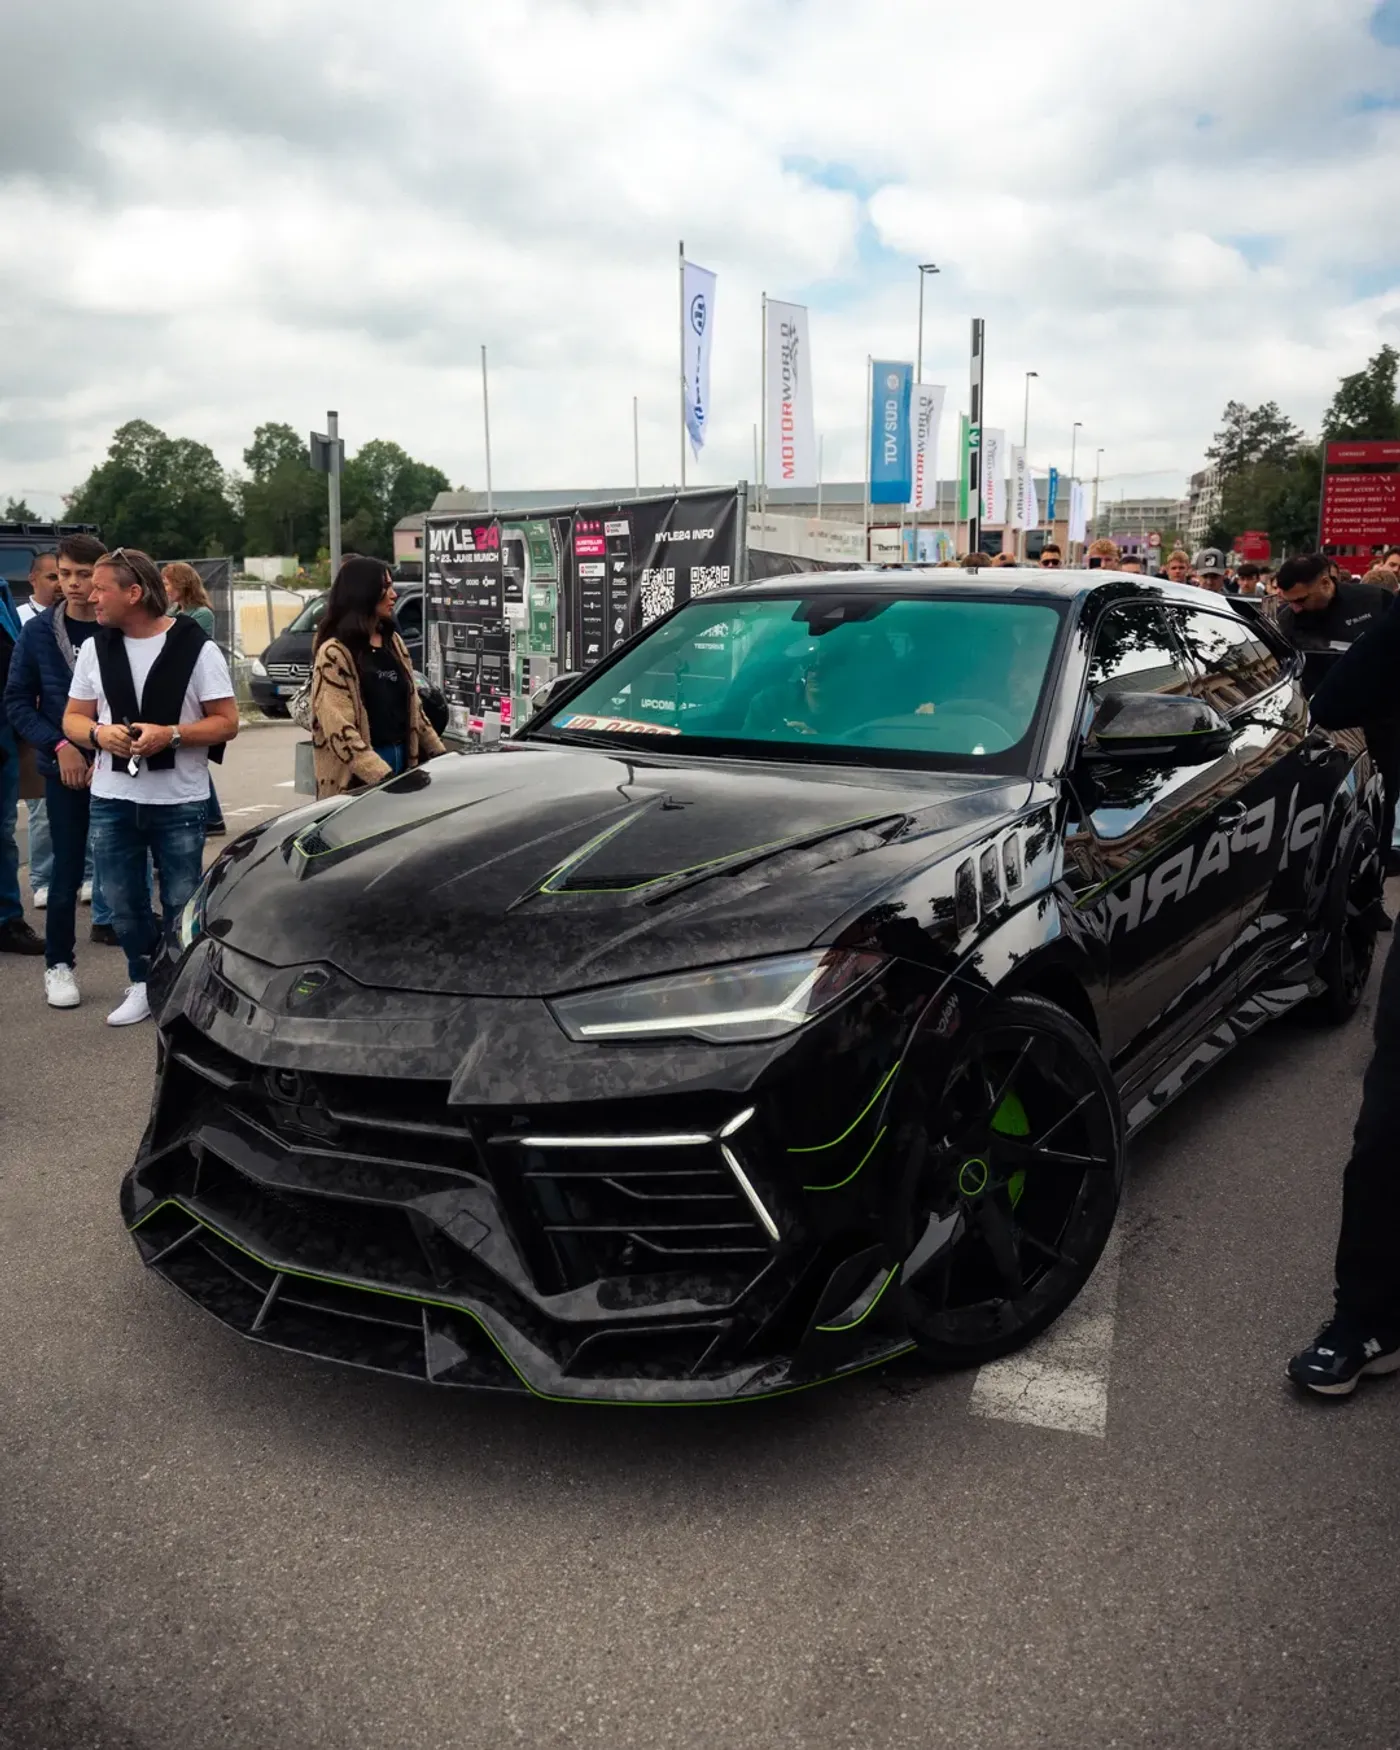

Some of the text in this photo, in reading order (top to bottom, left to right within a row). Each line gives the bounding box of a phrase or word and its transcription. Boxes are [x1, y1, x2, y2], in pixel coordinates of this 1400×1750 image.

[780, 322, 795, 480] MOTORWORLD
[915, 396, 927, 508] MOTORWORLD
[692, 528, 714, 540] INFO
